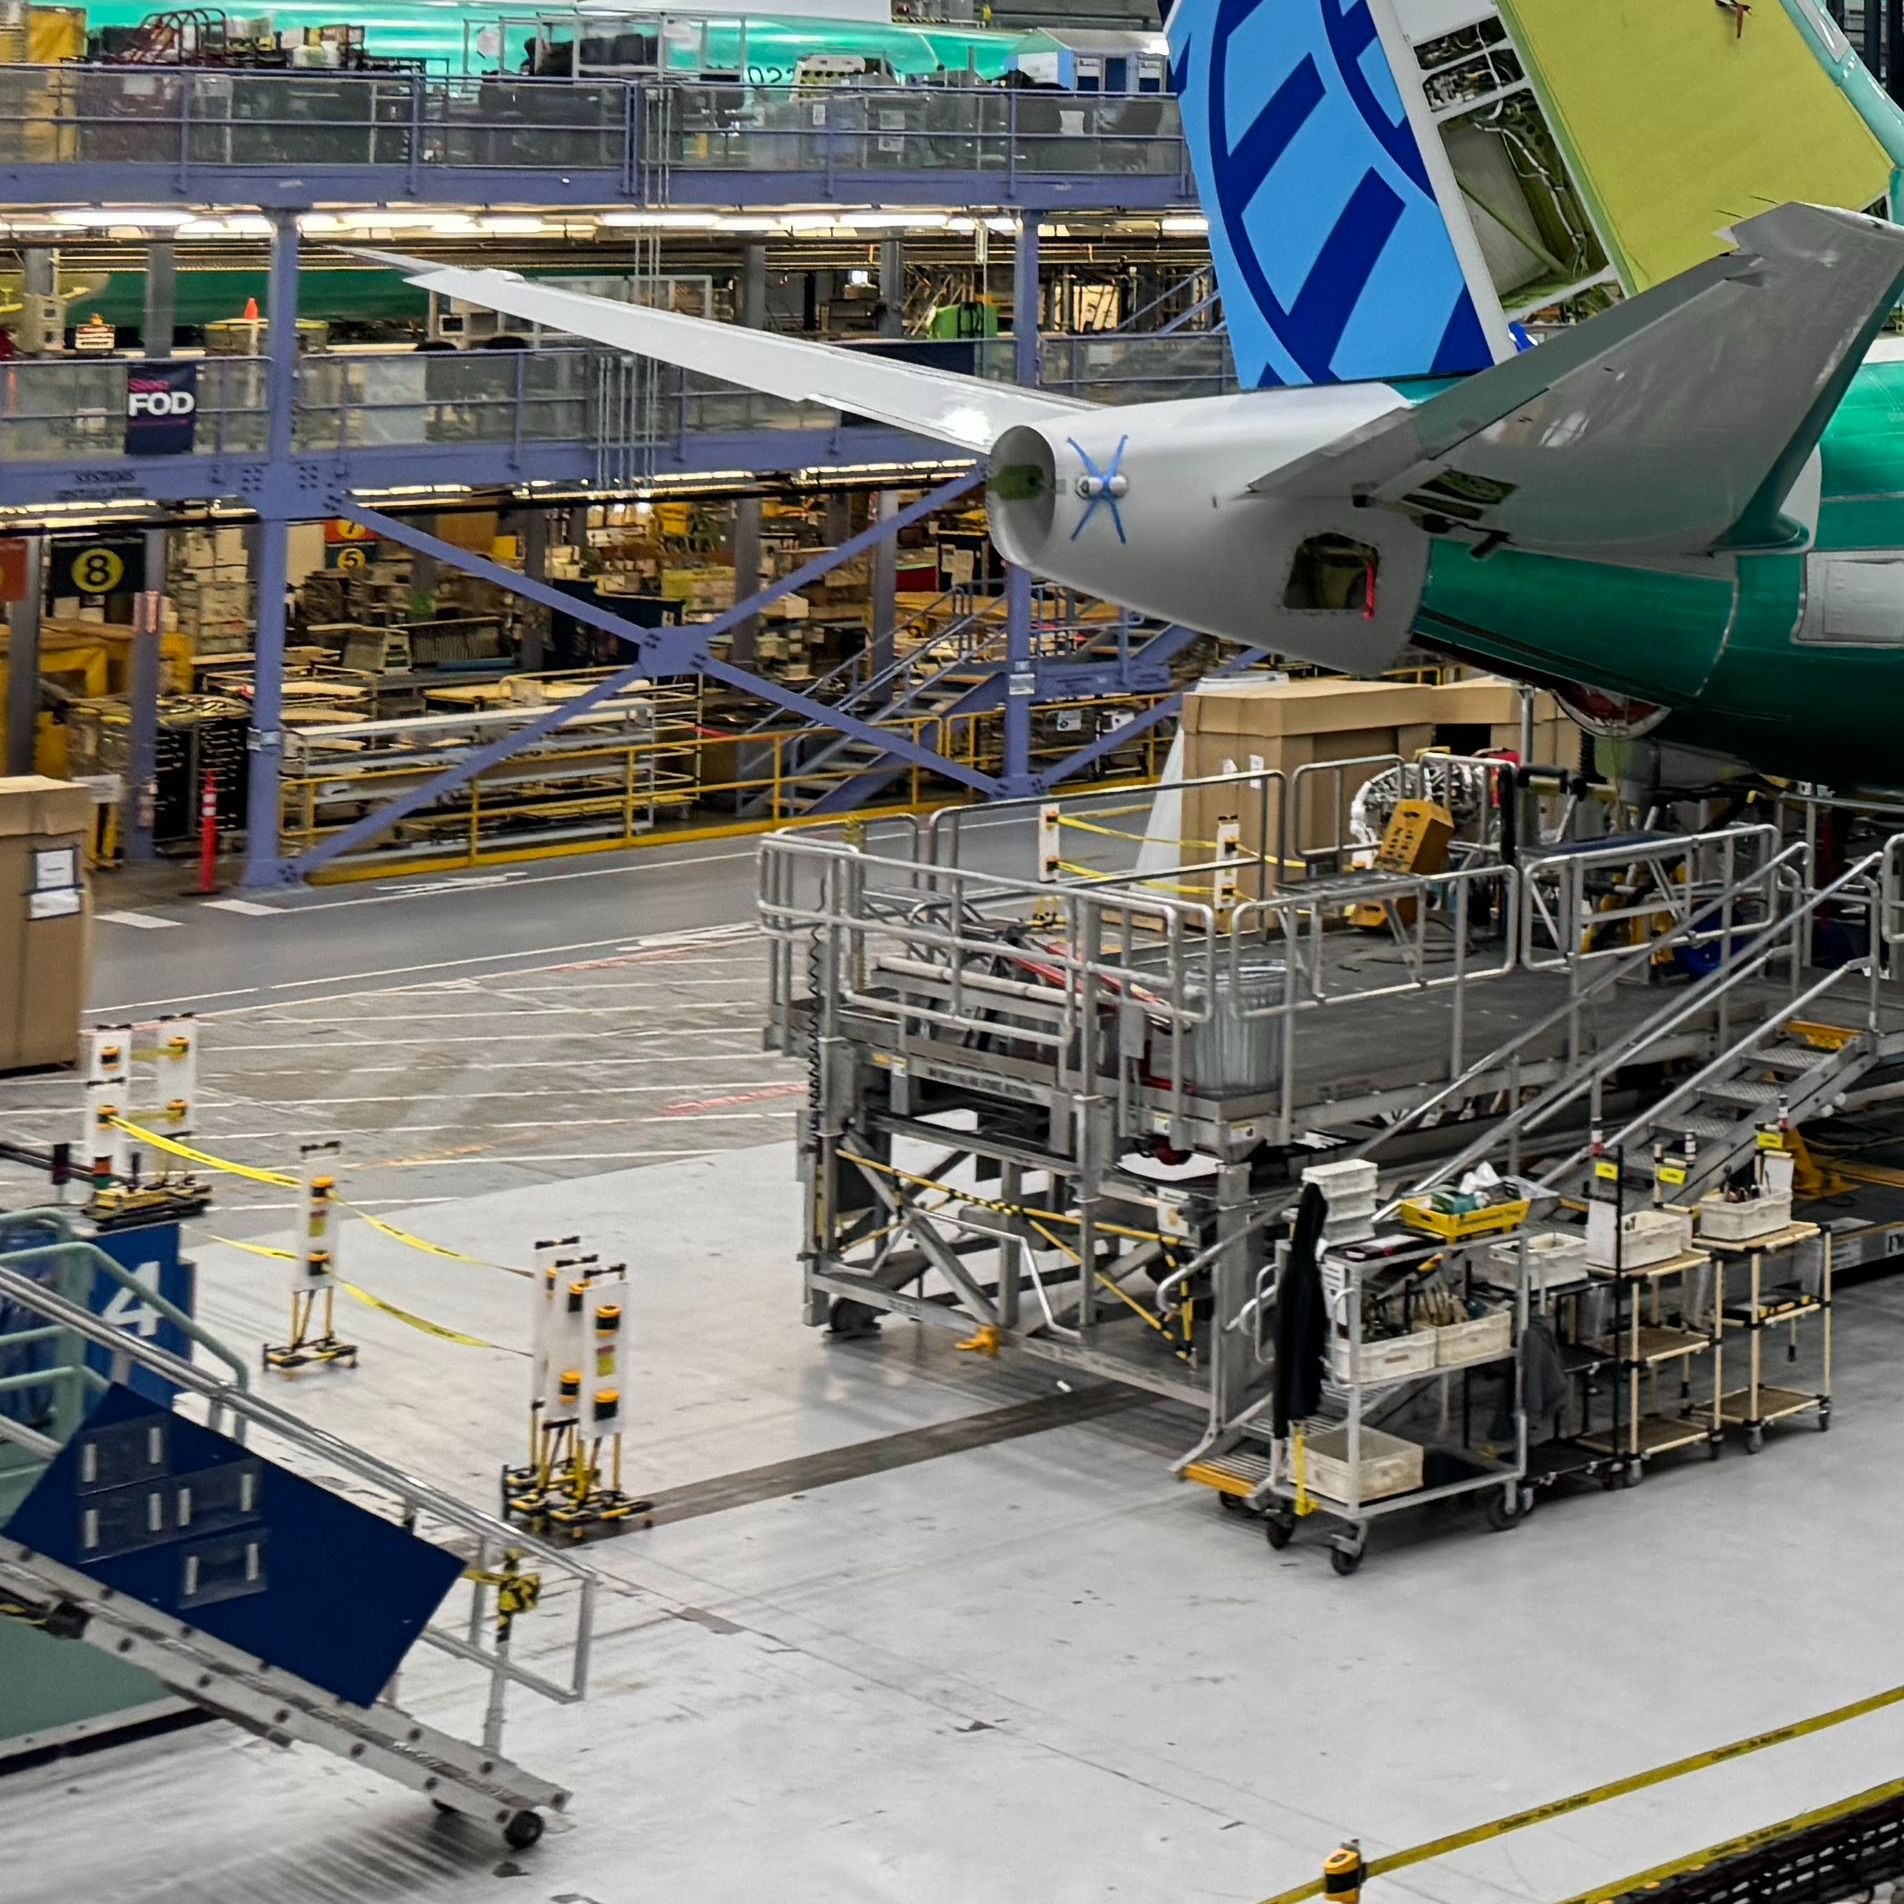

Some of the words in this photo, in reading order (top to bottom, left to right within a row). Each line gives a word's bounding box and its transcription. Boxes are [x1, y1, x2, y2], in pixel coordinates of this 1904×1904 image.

[128, 391, 195, 417] FOD
[86, 553, 111, 587] 8
[102, 1260, 166, 1336] 4
